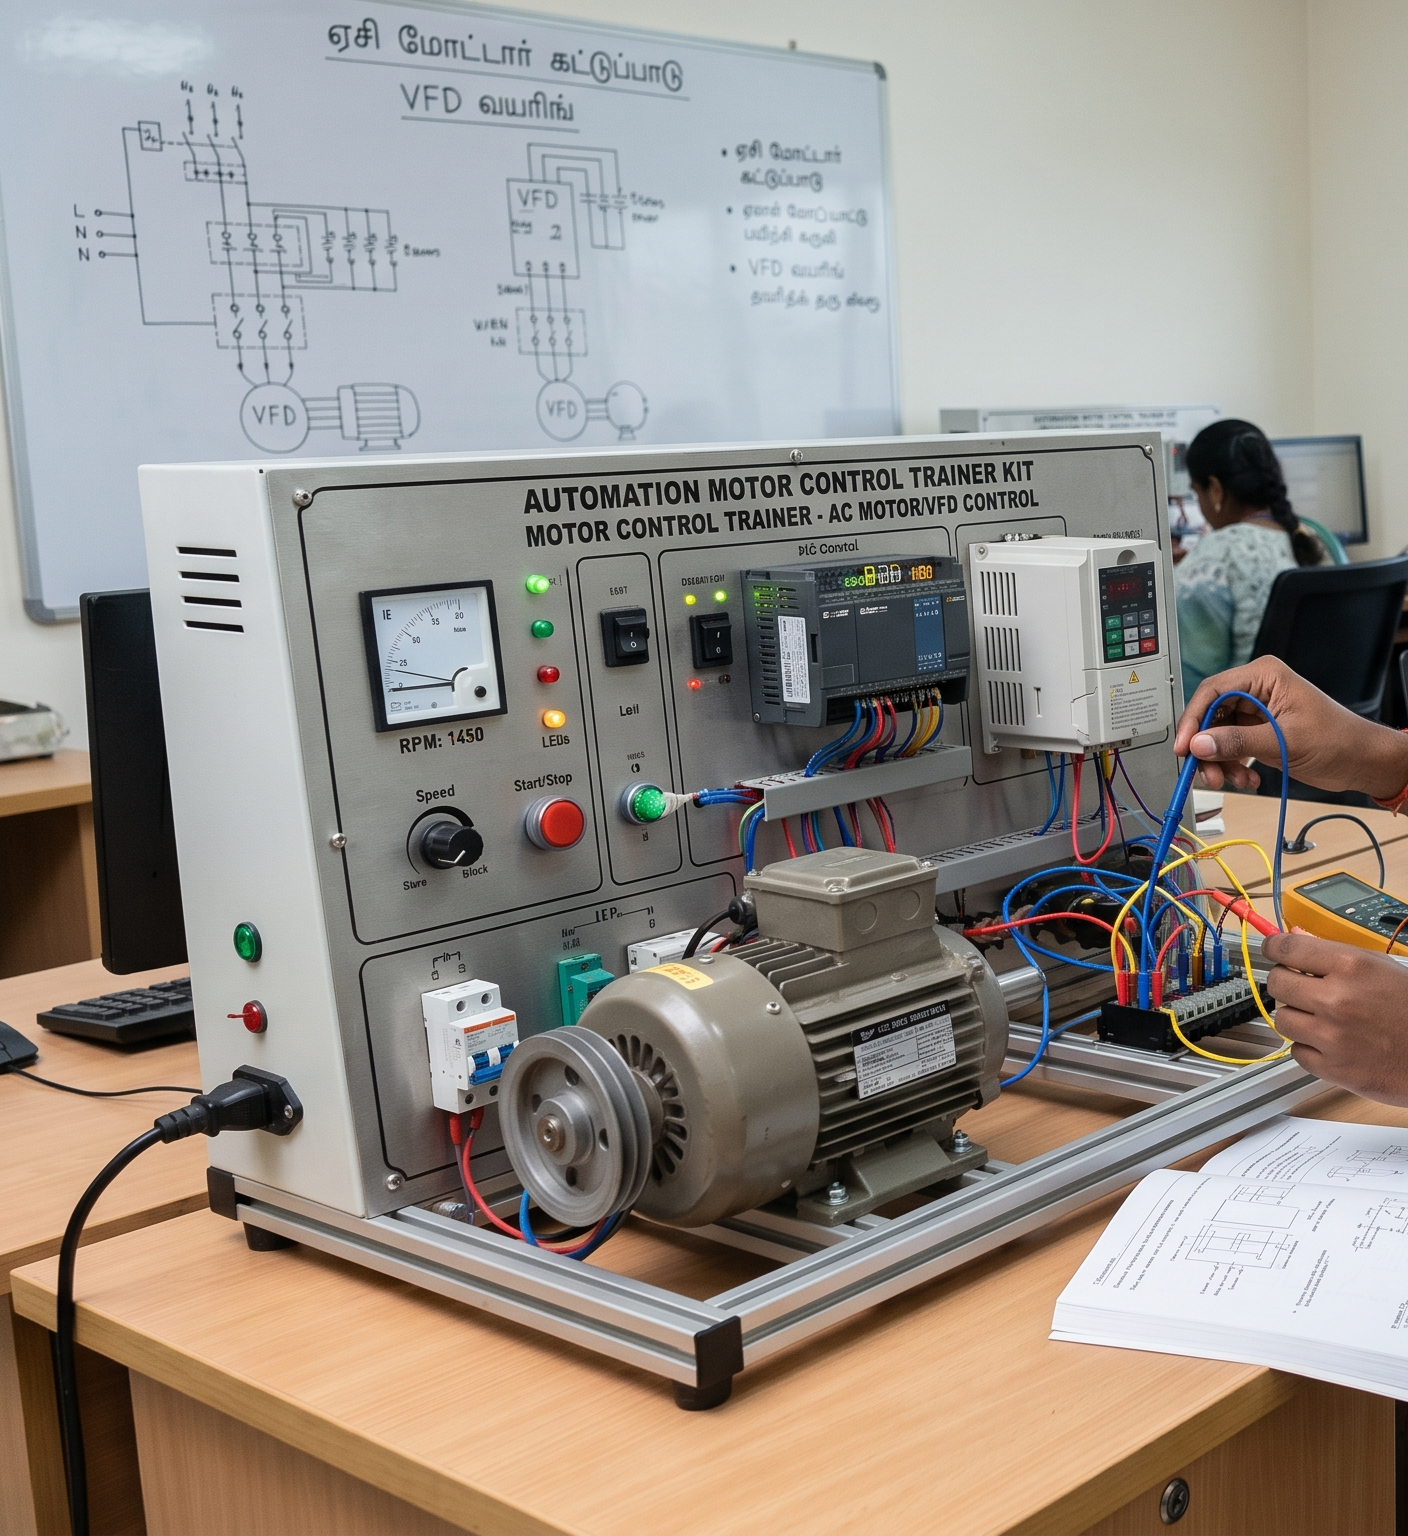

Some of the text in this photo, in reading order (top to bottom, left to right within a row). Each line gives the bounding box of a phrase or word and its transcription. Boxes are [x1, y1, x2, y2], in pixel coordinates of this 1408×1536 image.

[328, 18, 684, 92] ஏசி மோட்டார் கட்டுப்பாடு
[400, 83, 462, 114] VFD
[516, 188, 560, 210] VFD
[74, 204, 85, 218] L
[75, 225, 87, 239] N
[78, 247, 90, 262] N
[747, 258, 783, 278] VFD
[251, 404, 297, 427] VFD
[545, 399, 578, 420] VFD
[523, 460, 1034, 515] AUTOMATION MOTOR CONTROL TRAINER KIT
[525, 520, 611, 548] MOTOR
[616, 512, 720, 541] CONTROL
[723, 504, 813, 533] TRAINER
[828, 502, 854, 524] AC
[858, 494, 959, 521] MOTOR/VFD
[962, 488, 1040, 513] CONTROL
[399, 659, 408, 667] 25
[399, 726, 485, 754] RPM: 1450
[542, 734, 571, 748] LEDs
[514, 773, 573, 793] Start/Stop
[415, 784, 456, 805] Speed
